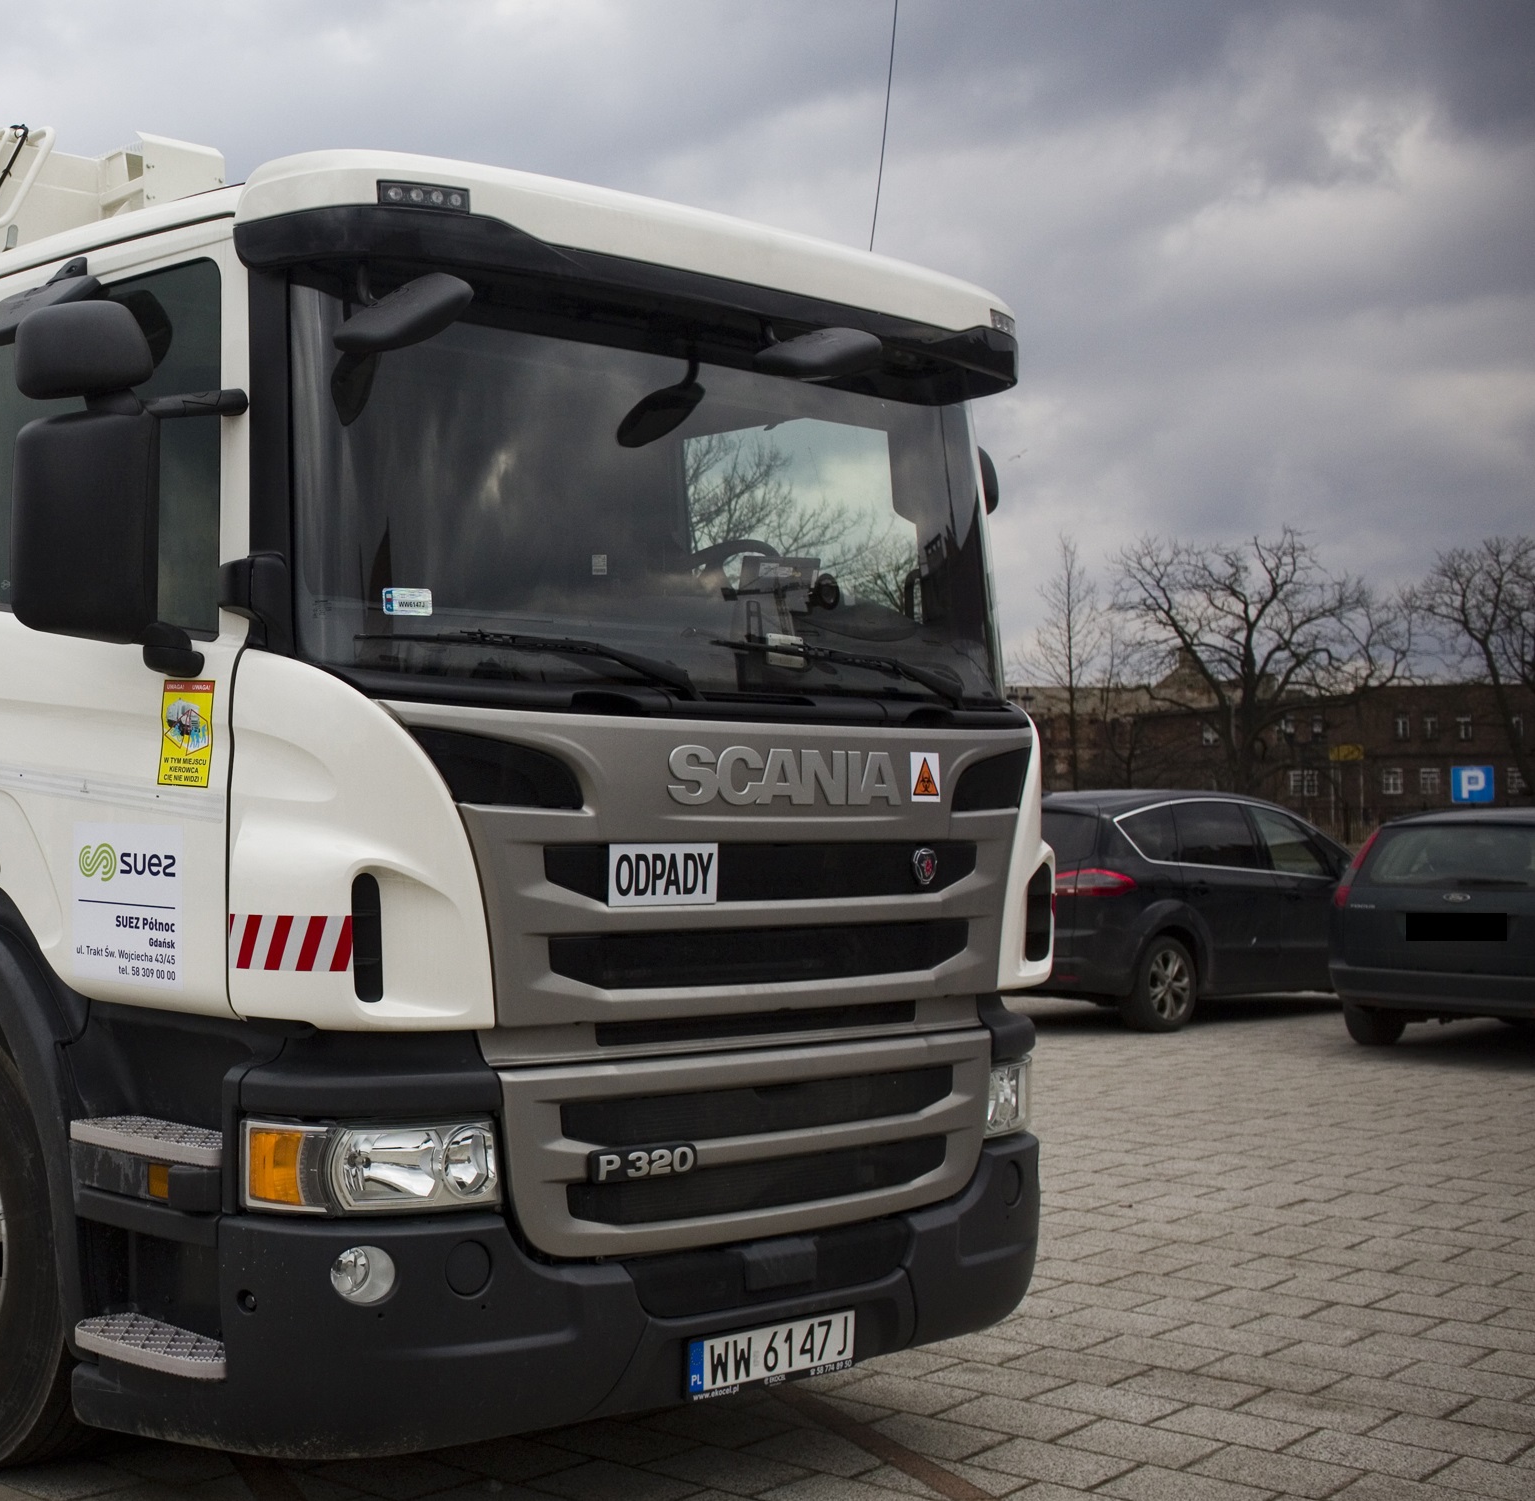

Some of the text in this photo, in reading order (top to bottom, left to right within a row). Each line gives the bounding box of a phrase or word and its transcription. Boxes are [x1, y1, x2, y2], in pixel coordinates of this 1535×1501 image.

[182, 758, 207, 766] MIEJSCU
[667, 744, 902, 806] SCANIA
[1460, 769, 1486, 799] P
[120, 852, 176, 877] suez
[615, 853, 714, 897] ODPADY
[115, 915, 176, 932] SUEZ Północ
[148, 937, 176, 949] Gdańsk
[76, 945, 176, 965] ul. Trakt Św. Wojciecha 43/45
[118, 965, 176, 981] tel. 58 309 00 00
[598, 1146, 695, 1181] P 320
[710, 1315, 848, 1386] WW 6147J
[816, 1366, 824, 1375] 58
[835, 1362, 843, 1370] 89
[691, 1374, 702, 1386] PL
[769, 1374, 786, 1384] EKOCEL
[692, 1384, 740, 1401] www.ekocel.pl
